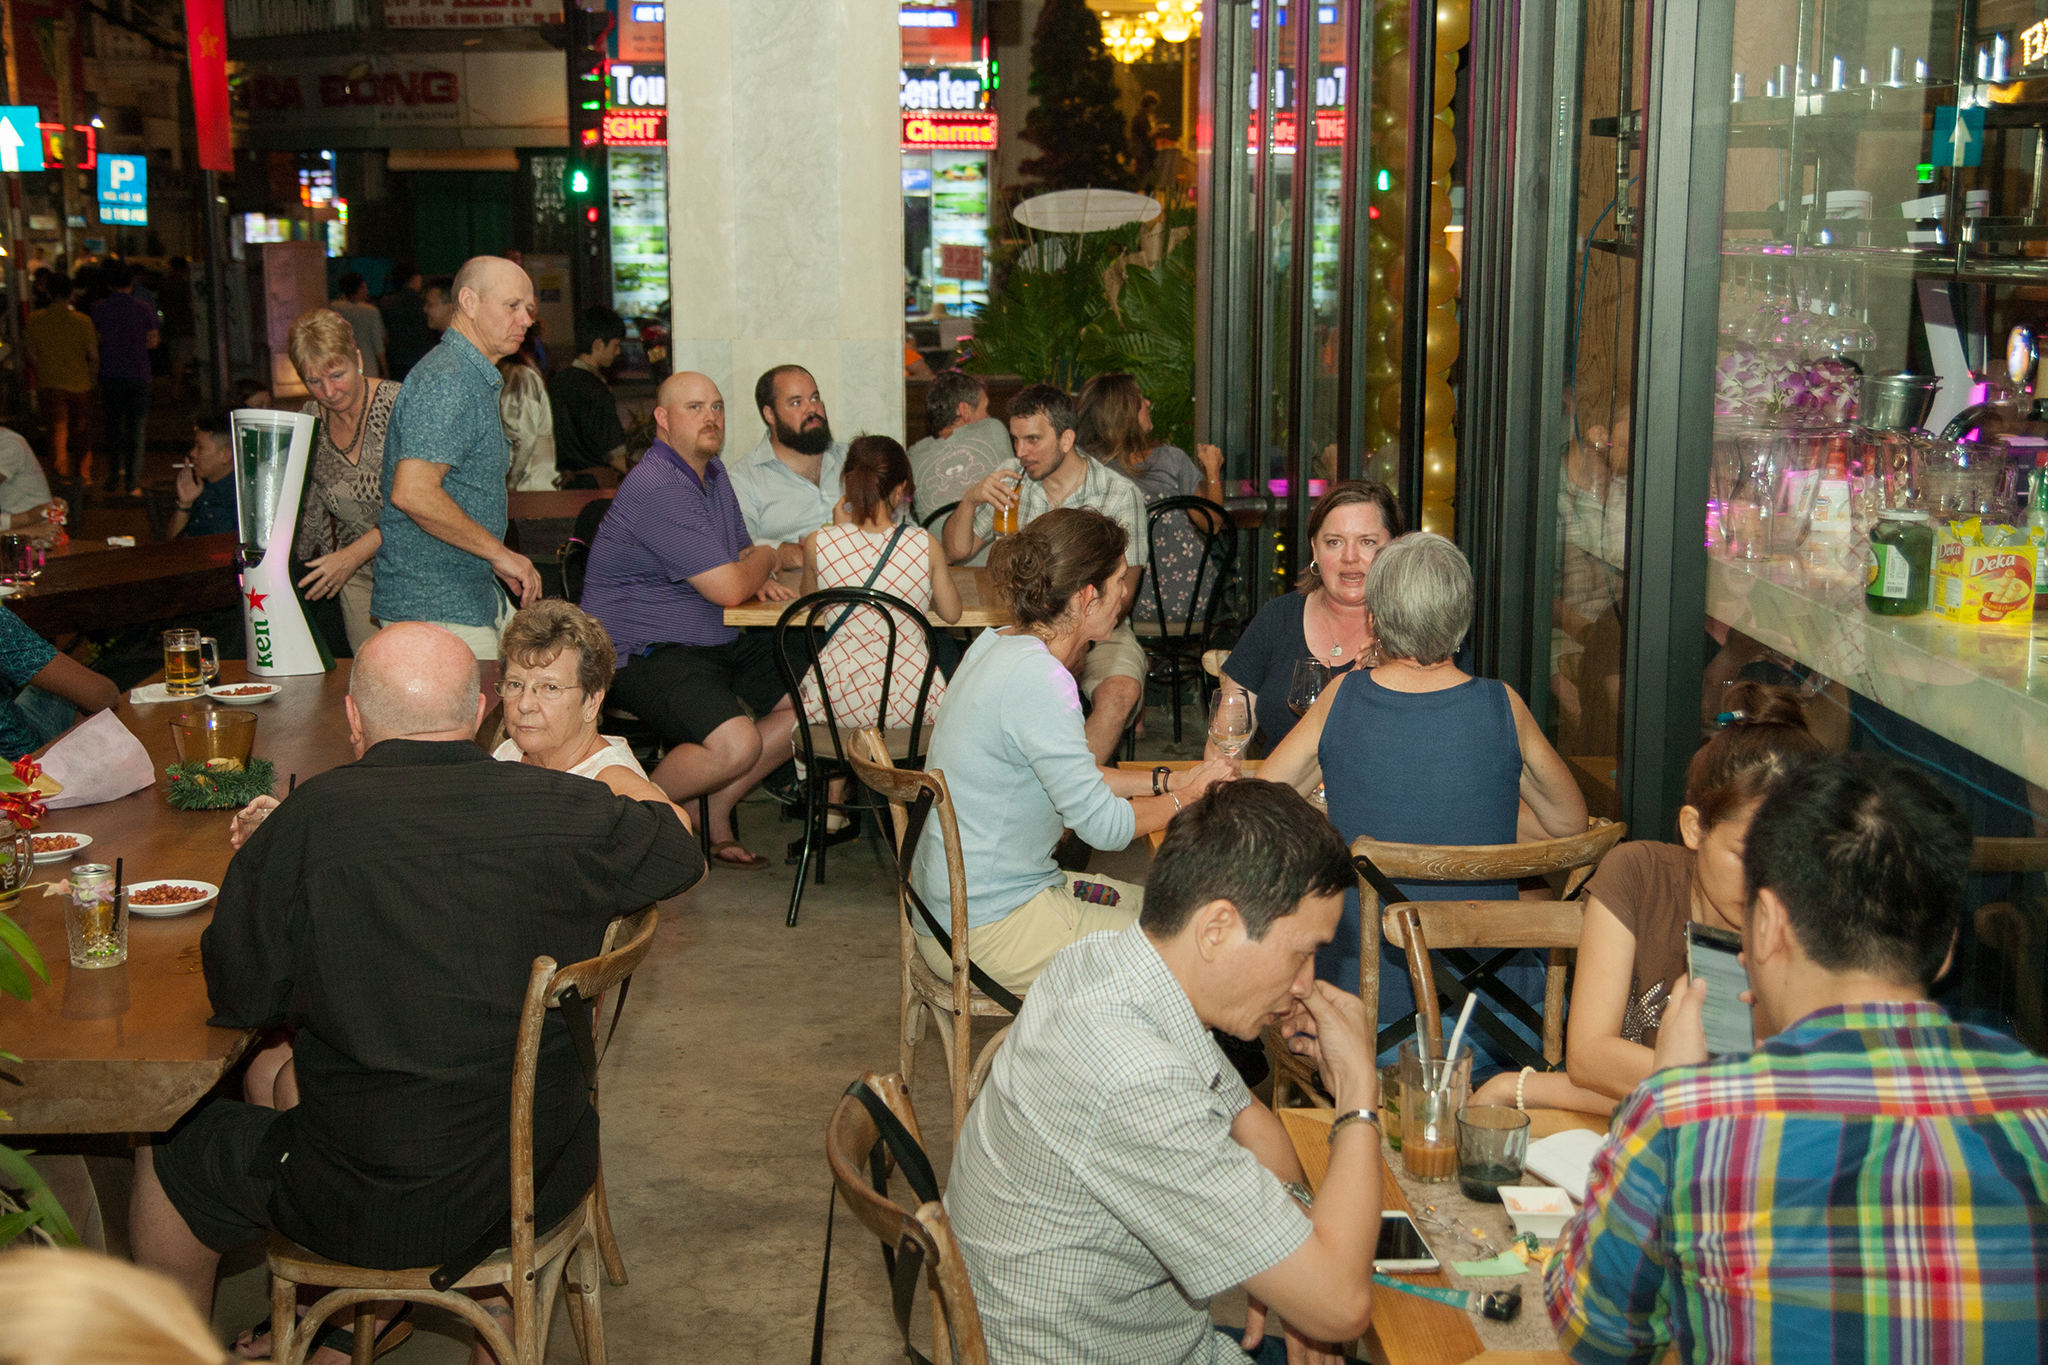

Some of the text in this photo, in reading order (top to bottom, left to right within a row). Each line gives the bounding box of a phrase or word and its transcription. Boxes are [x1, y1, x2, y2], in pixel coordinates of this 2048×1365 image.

[905, 119, 992, 142] Charms
[111, 159, 135, 189] P
[1938, 543, 1961, 558] Deka
[1970, 552, 2015, 577] Deka
[254, 619, 273, 668] ken
